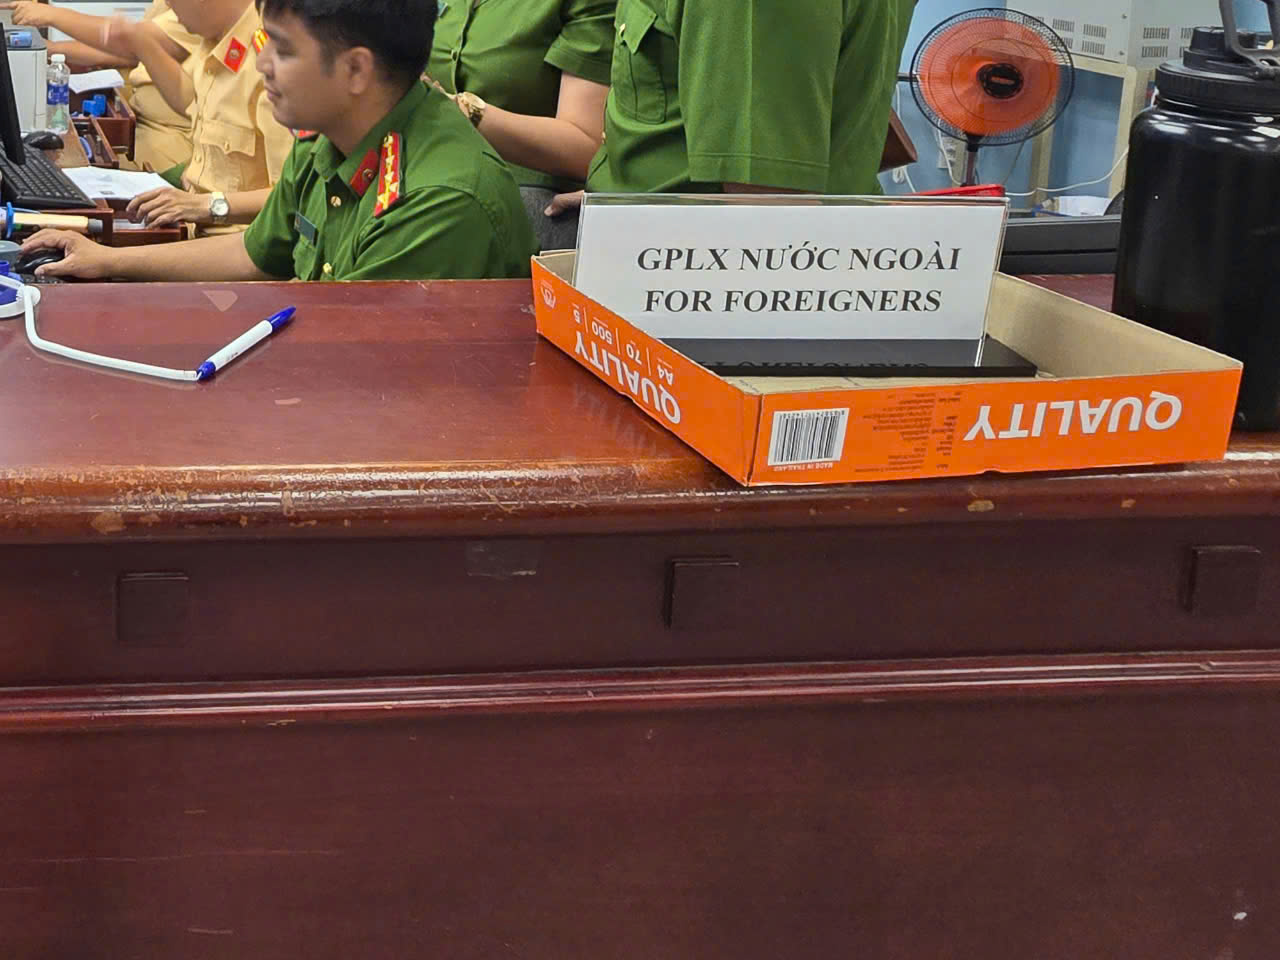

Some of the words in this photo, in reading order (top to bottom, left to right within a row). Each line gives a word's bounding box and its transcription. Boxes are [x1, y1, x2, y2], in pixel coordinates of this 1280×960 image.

[637, 247, 729, 271] GPLX
[740, 240, 840, 271] NƯỚC
[849, 240, 961, 271] NGOÀI
[644, 289, 712, 313] FOR
[724, 289, 942, 313] FOREIGNERS
[591, 320, 614, 344] 500
[625, 343, 643, 365] 70
[573, 329, 682, 425] QUALITY
[656, 364, 674, 385] A4
[963, 390, 1183, 441] QUALITY
